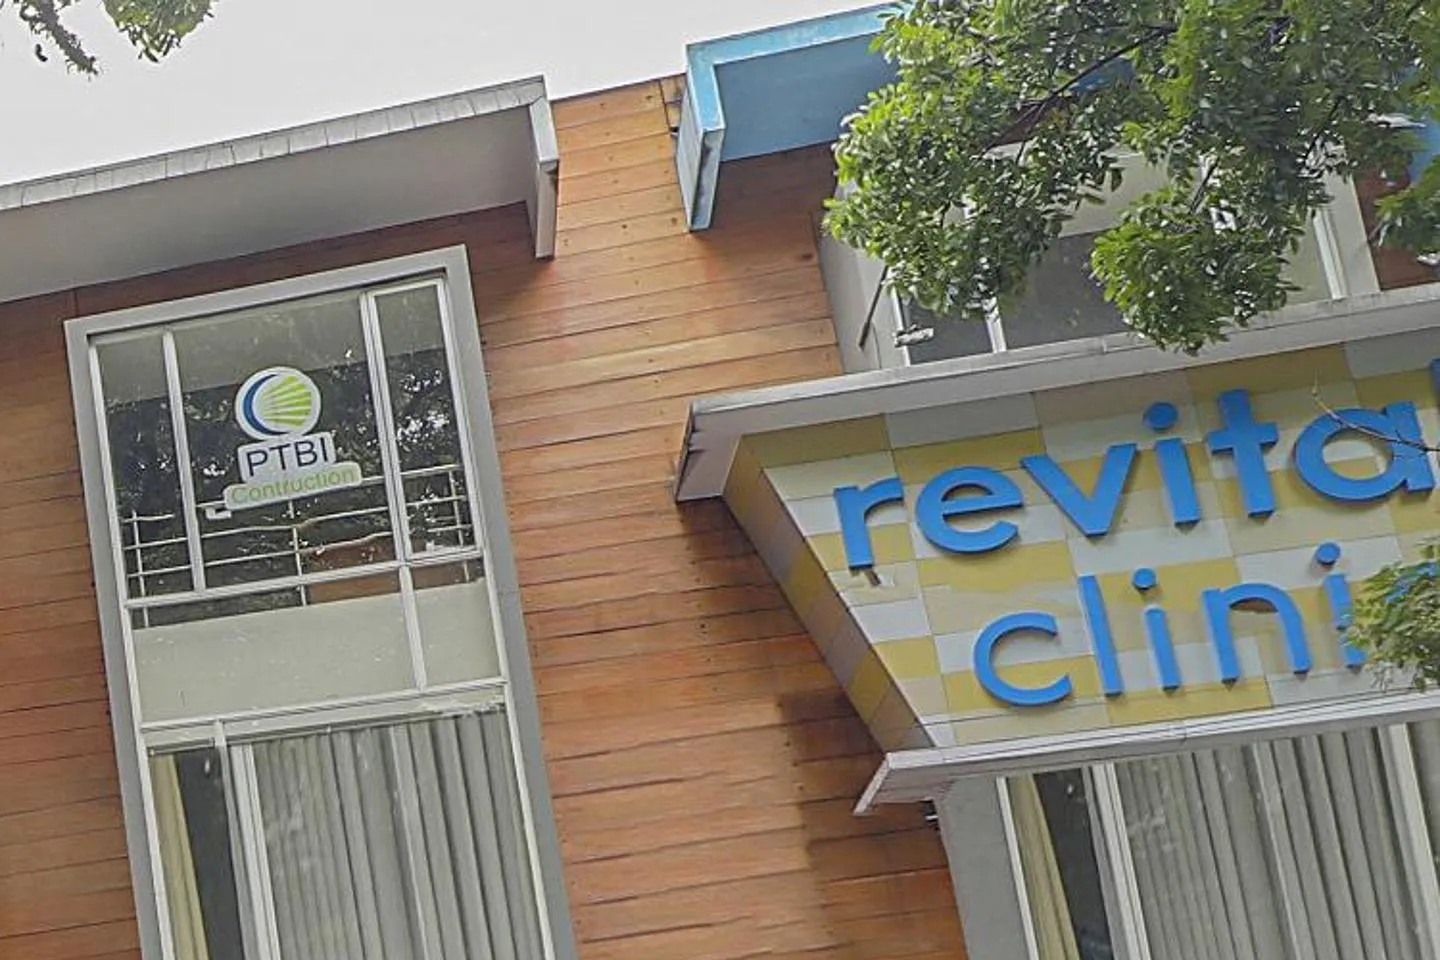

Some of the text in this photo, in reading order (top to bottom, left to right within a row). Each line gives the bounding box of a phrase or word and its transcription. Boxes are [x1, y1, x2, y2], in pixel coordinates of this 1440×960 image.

[230, 468, 355, 503] Contruction
[245, 436, 330, 477] PTBI
[833, 357, 1440, 570] revita
[973, 541, 1440, 707] clini
